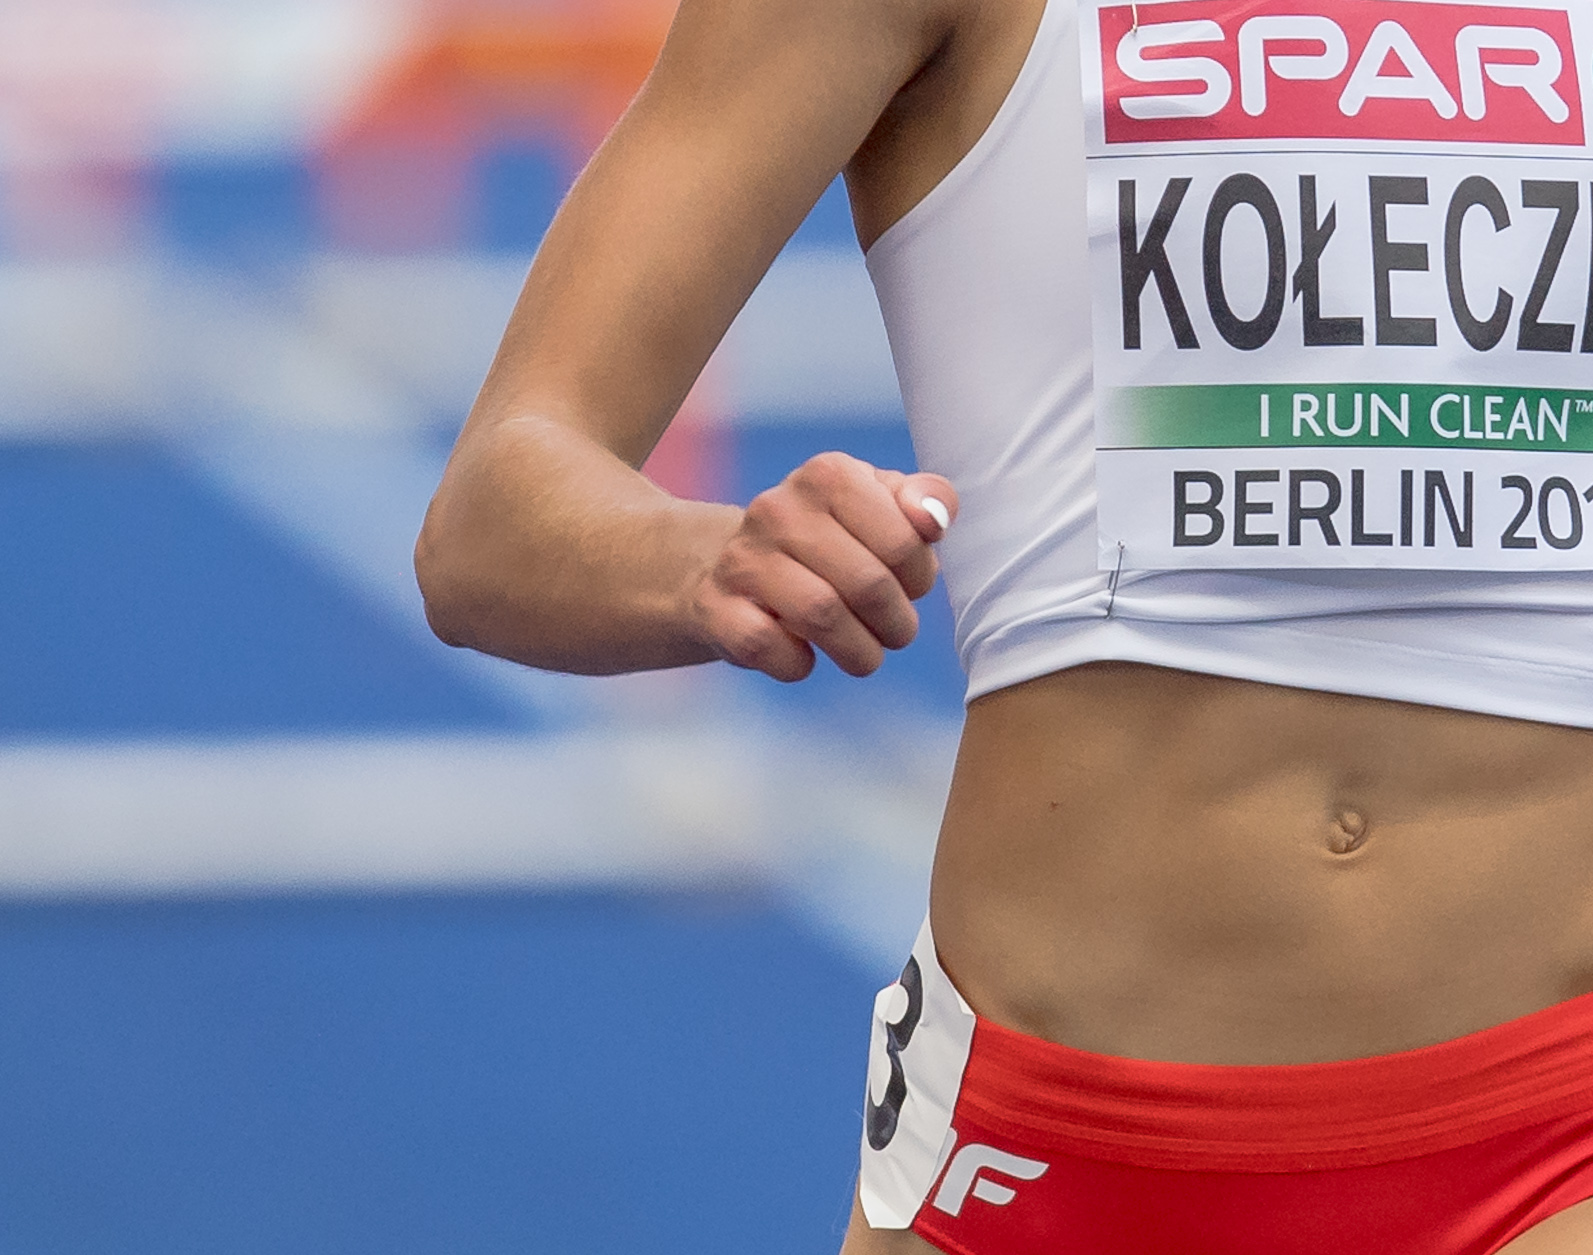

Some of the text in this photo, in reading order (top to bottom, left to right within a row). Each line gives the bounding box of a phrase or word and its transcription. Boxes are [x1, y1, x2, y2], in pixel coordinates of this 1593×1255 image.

[1115, 15, 1570, 124] SPAR
[1260, 395, 1270, 437] I
[1291, 393, 1410, 438] RUN
[1172, 469, 1474, 548] BERLIN
